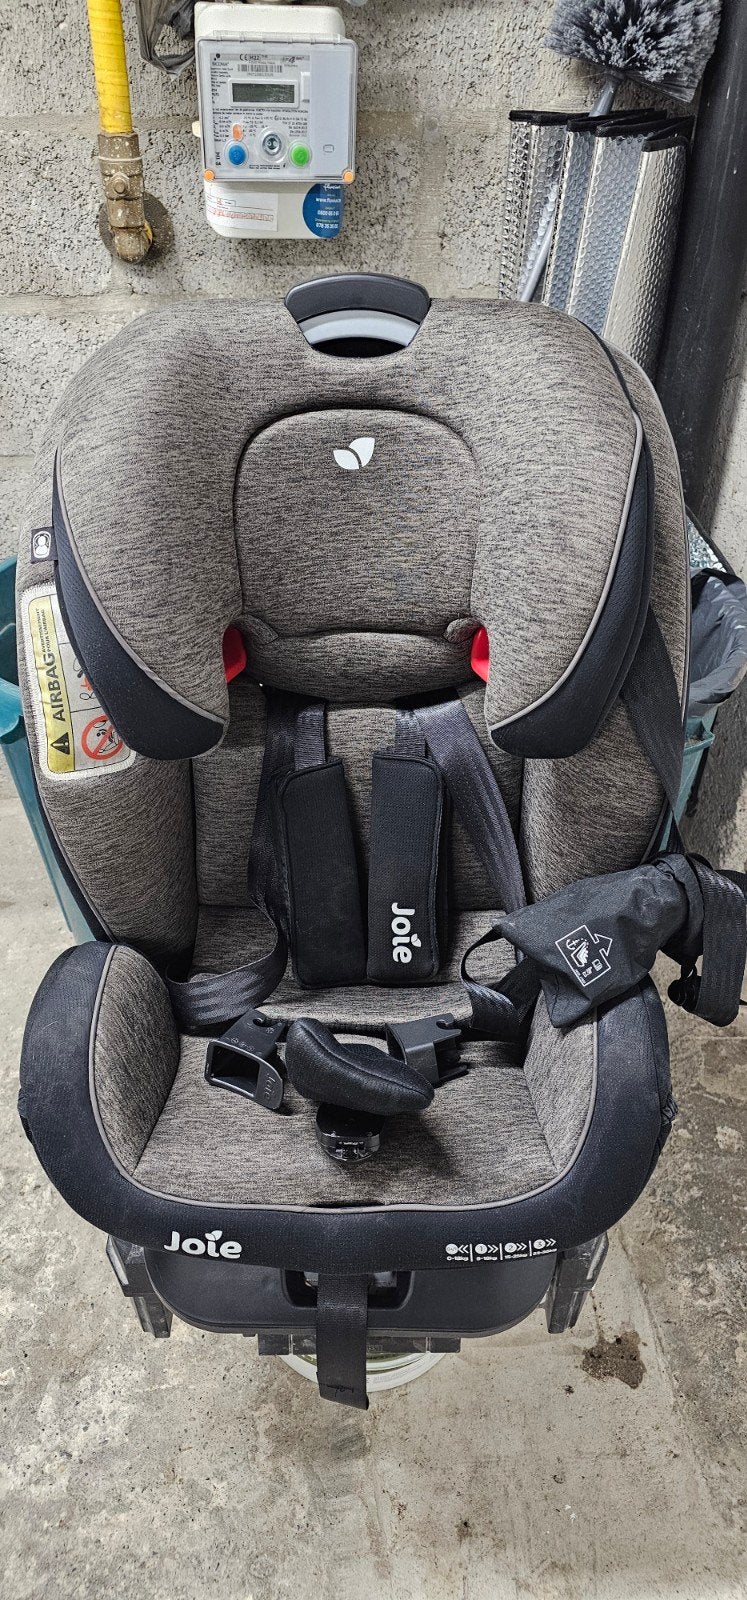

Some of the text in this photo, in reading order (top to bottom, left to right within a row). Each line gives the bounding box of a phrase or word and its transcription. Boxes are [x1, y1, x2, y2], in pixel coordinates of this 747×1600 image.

[43, 652, 66, 722] AIRBAG
[391, 902, 422, 964] Joie
[163, 1229, 243, 1259] Joie
